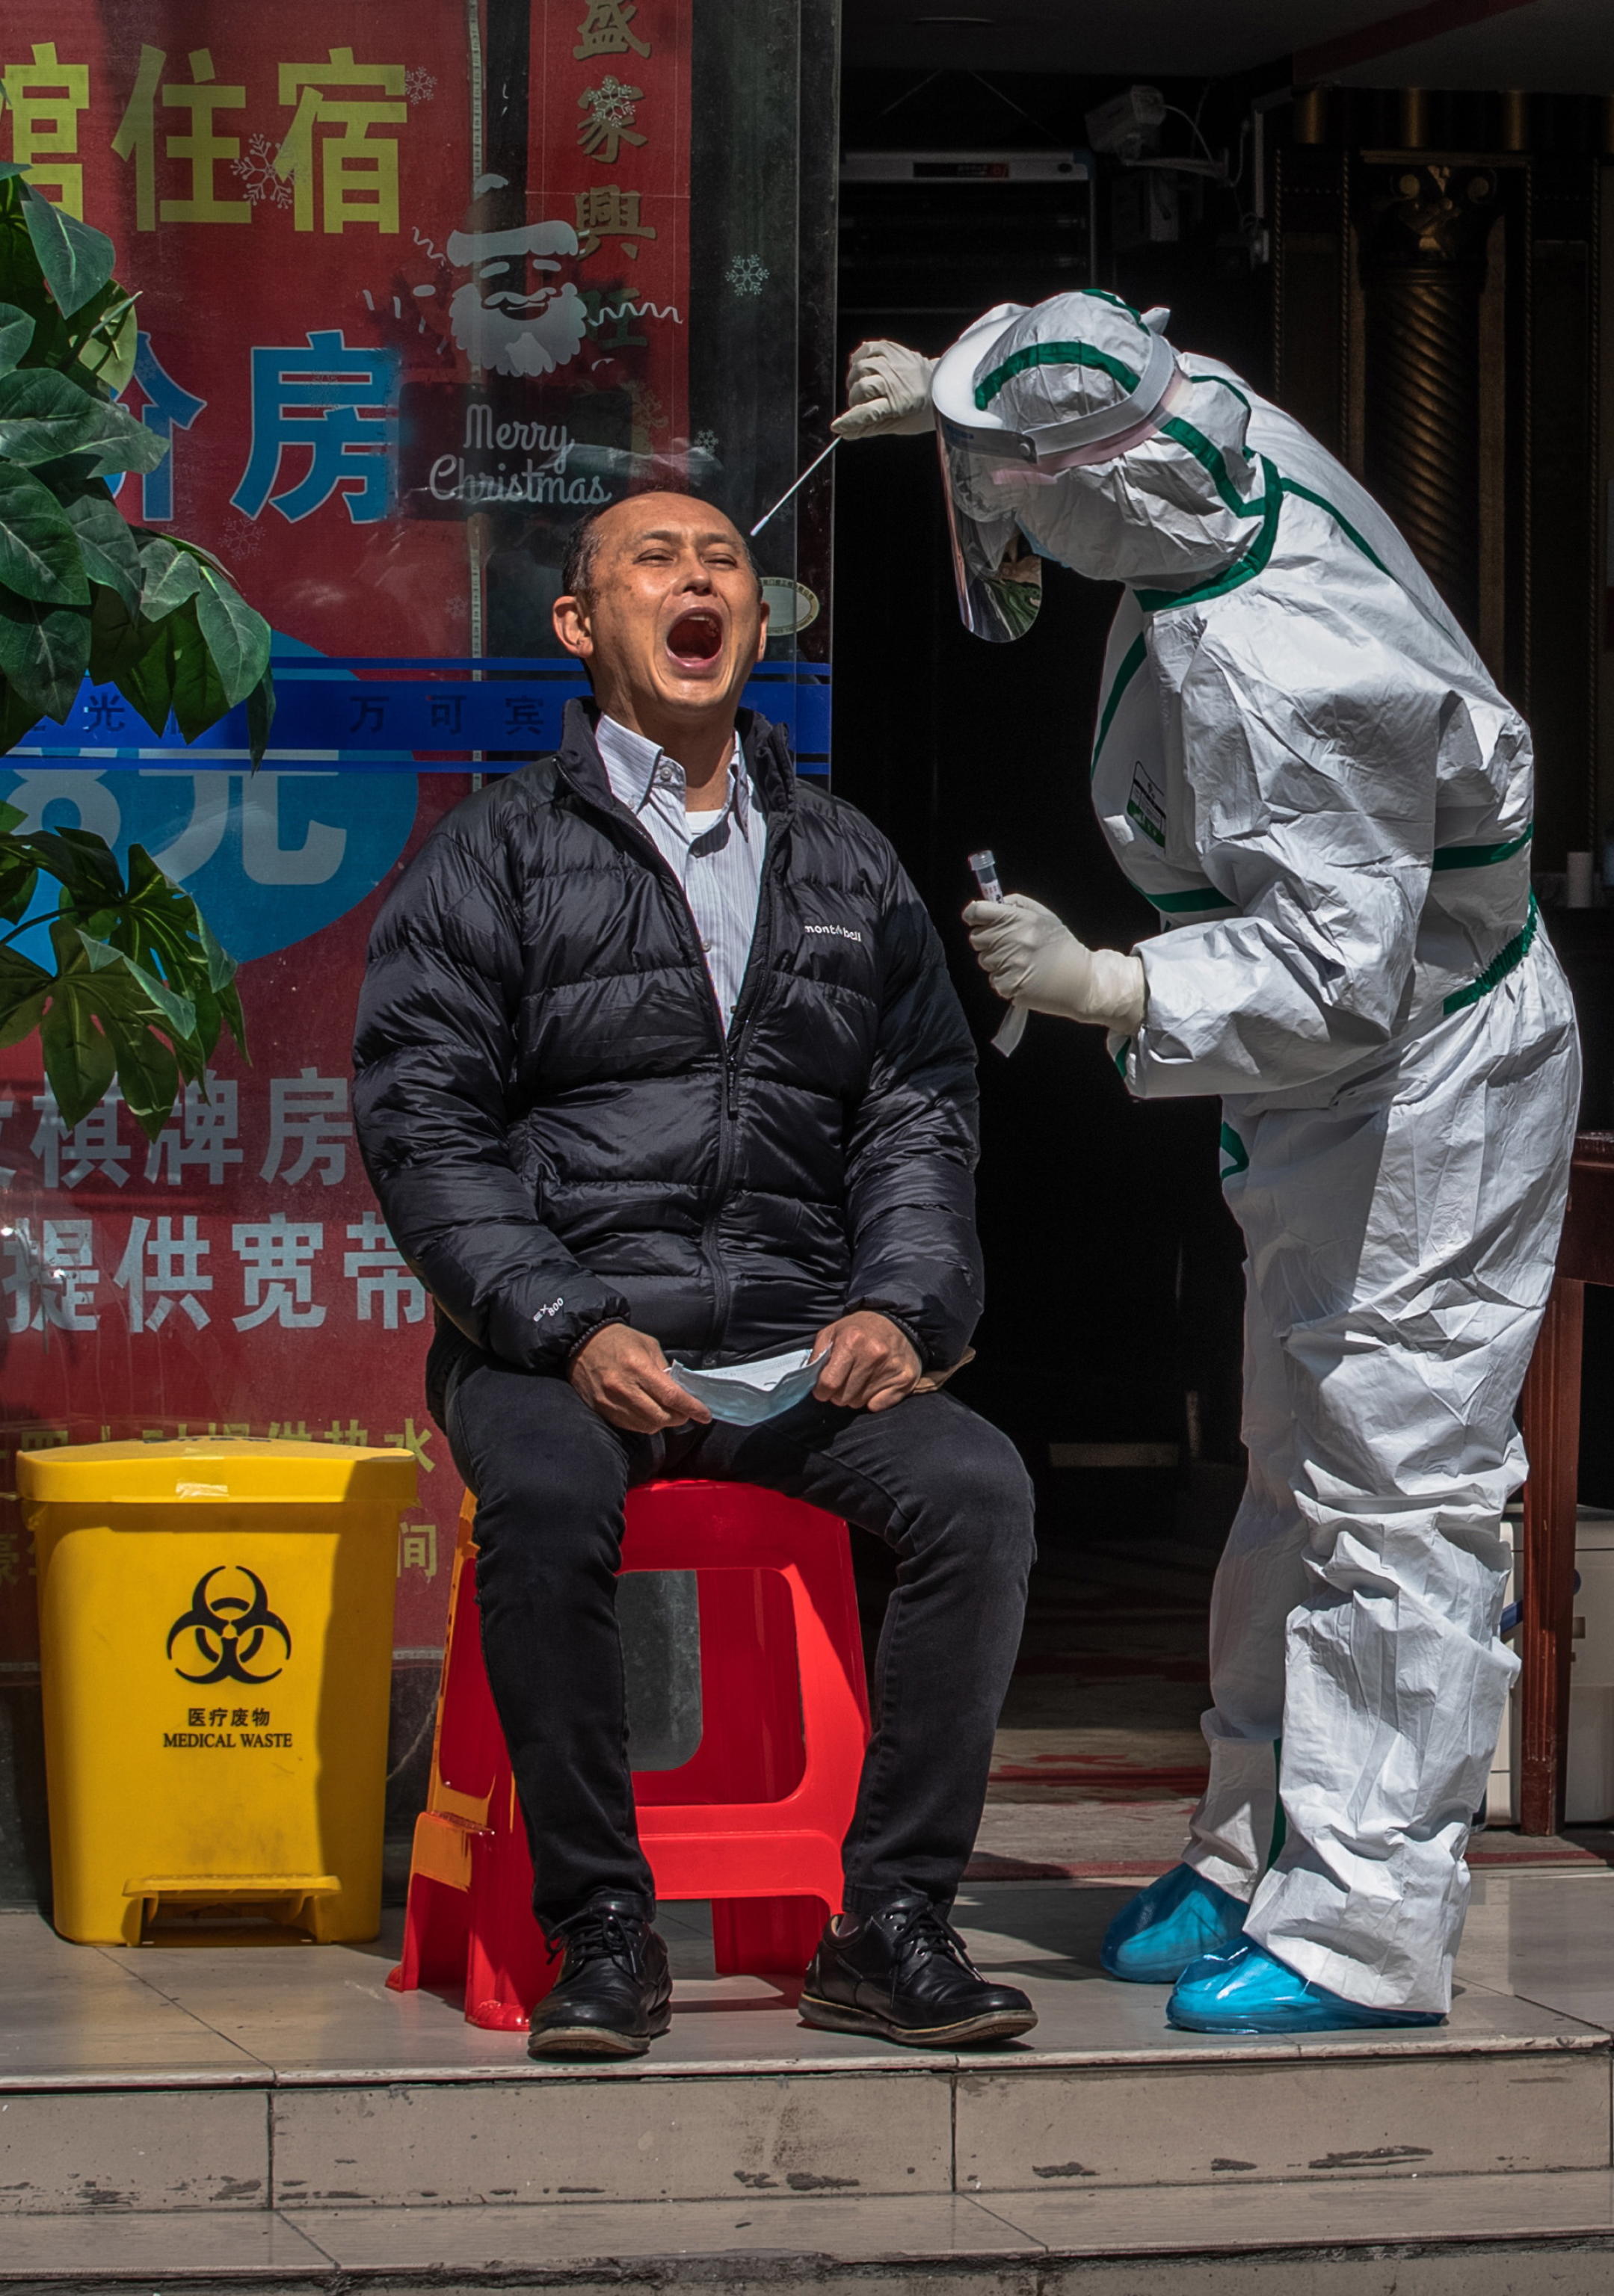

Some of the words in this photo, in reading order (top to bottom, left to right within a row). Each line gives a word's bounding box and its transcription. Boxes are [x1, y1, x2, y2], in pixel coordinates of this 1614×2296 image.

[463, 404, 575, 474] Merry
[429, 454, 613, 504] Christmas
[0, 1067, 354, 1188] 棋牌房
[1, 1212, 427, 1333] 提供宽带
[163, 1732, 236, 1747] MEDICAL
[240, 1732, 293, 1747] WASTE
[188, 1707, 271, 1727] 医疗废物
